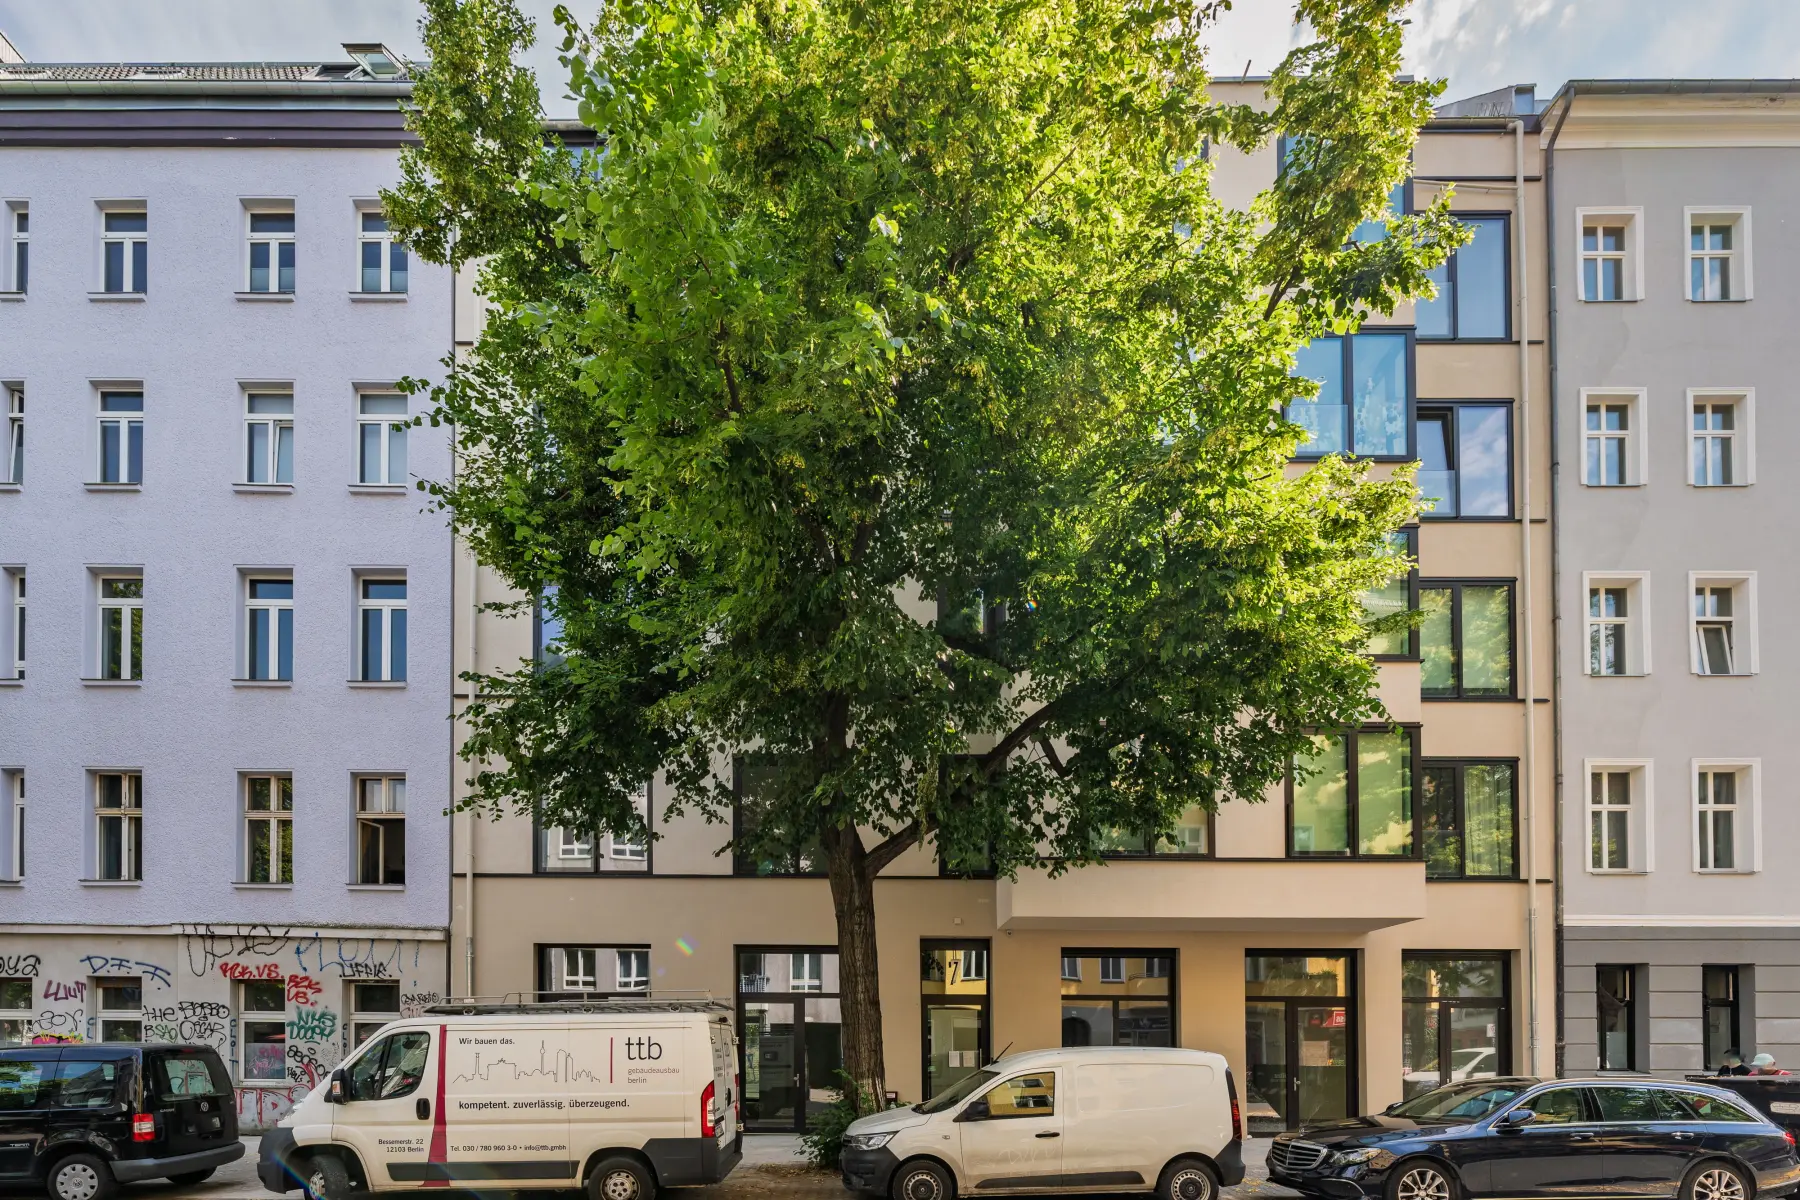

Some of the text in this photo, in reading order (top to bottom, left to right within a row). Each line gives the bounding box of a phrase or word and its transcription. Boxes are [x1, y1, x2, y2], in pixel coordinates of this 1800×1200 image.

[949, 961, 959, 985] 7
[458, 1037, 515, 1045] Wir bauen das.
[625, 1036, 662, 1060] ttb
[628, 1076, 647, 1084] berlin
[458, 1098, 630, 1111] kompetent. zuverlässig. überzeugend.
